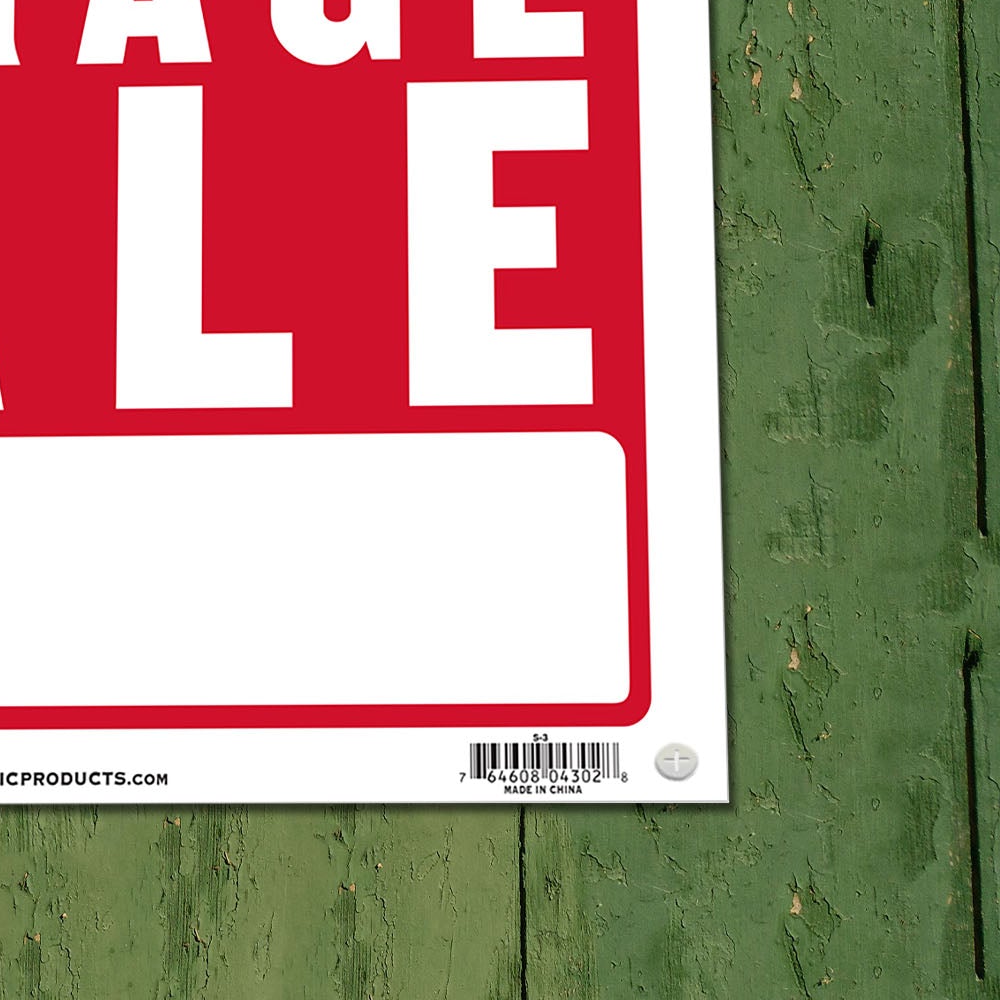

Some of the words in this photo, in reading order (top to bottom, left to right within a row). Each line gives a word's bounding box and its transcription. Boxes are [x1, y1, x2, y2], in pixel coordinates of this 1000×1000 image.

[532, 733, 549, 742] S-3
[487, 769, 540, 783] 64608
[549, 769, 602, 783] 04302
[504, 785, 533, 795] MADE
[536, 785, 547, 795] IN
[550, 785, 583, 795] CHINA
